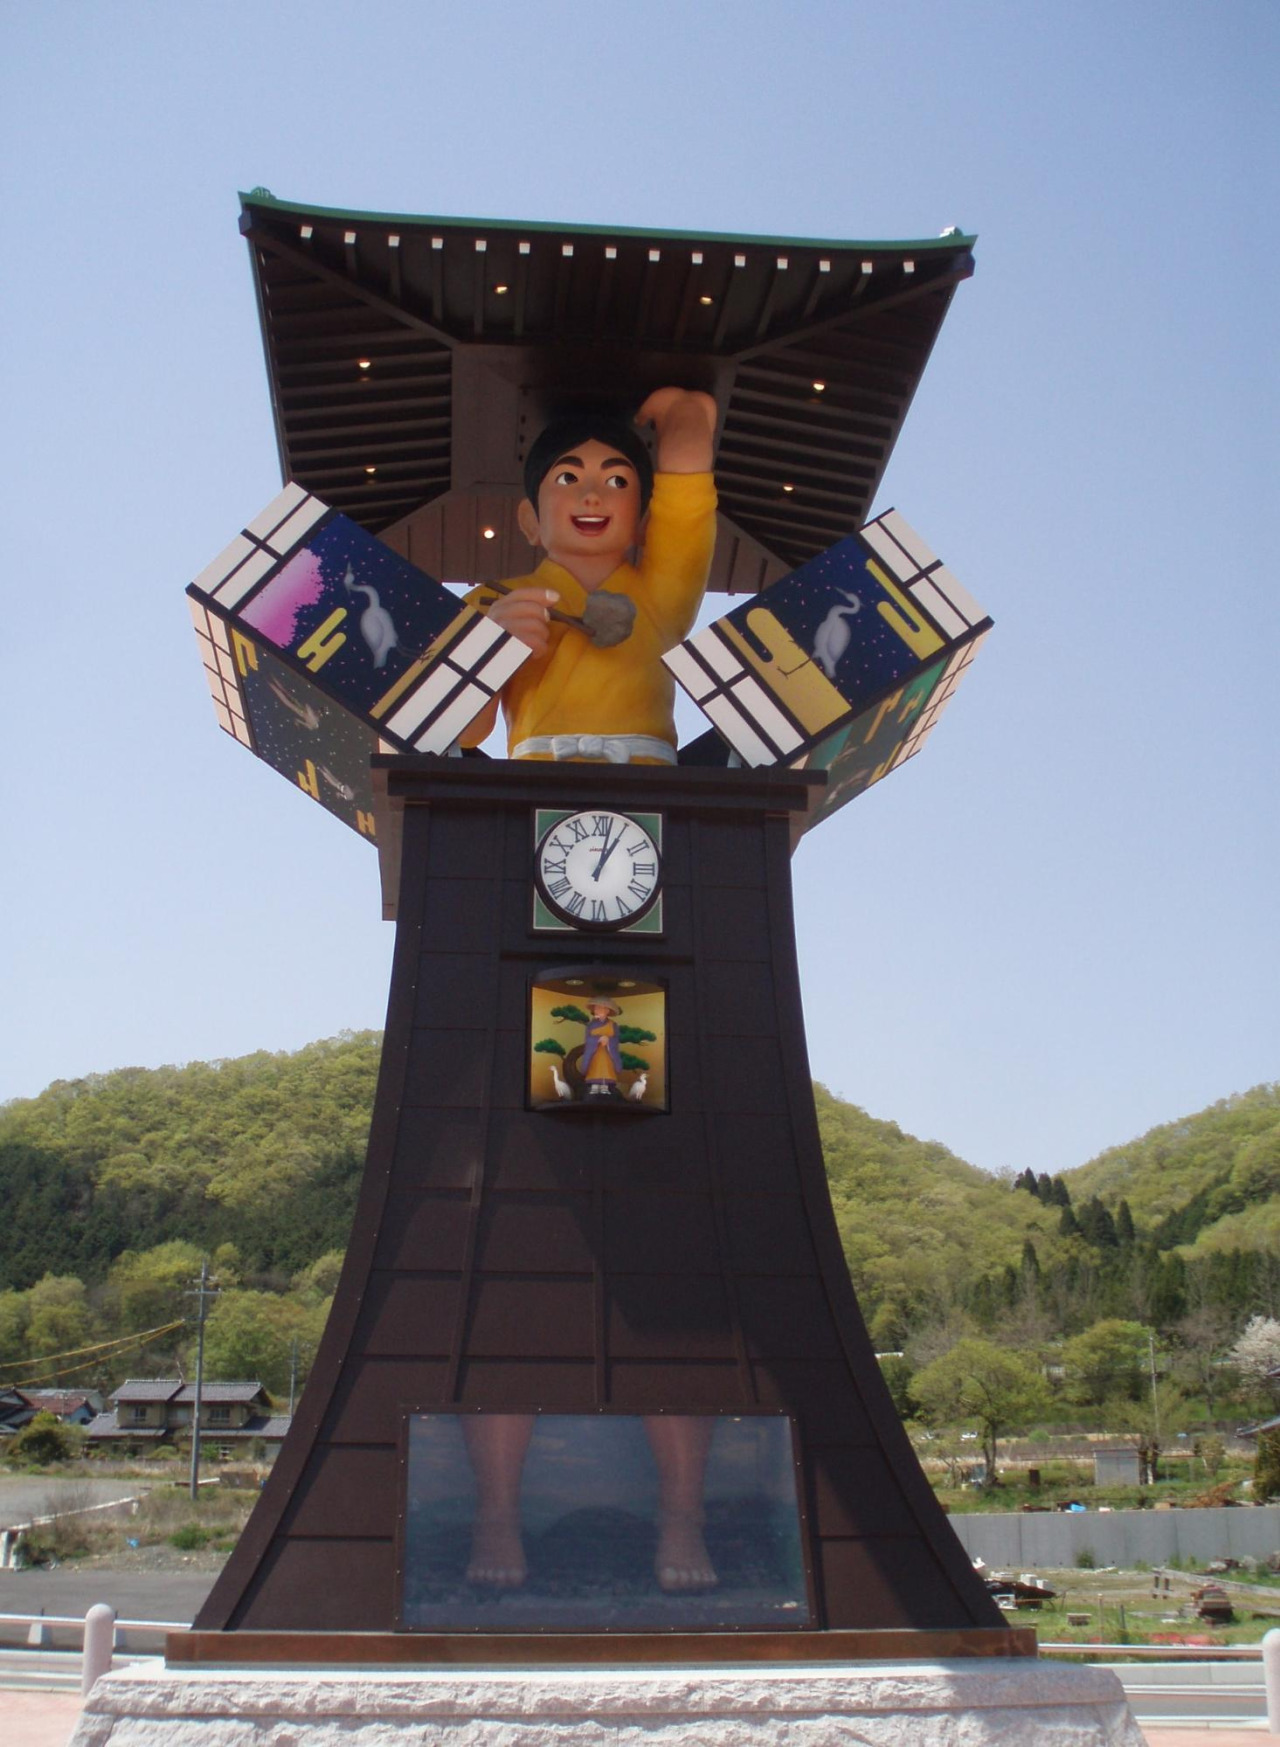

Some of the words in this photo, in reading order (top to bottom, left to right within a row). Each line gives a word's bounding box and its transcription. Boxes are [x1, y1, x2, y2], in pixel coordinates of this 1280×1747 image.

[566, 819, 590, 843] XI
[591, 815, 610, 837] XII
[549, 835, 574, 857] X
[627, 839, 650, 857] II
[544, 858, 567, 875] IX
[633, 862, 656, 877] III
[548, 876, 573, 900] VIII
[628, 879, 651, 902] IV
[564, 891, 587, 917] VII
[590, 899, 609, 922] VI
[616, 896, 633, 918] V
